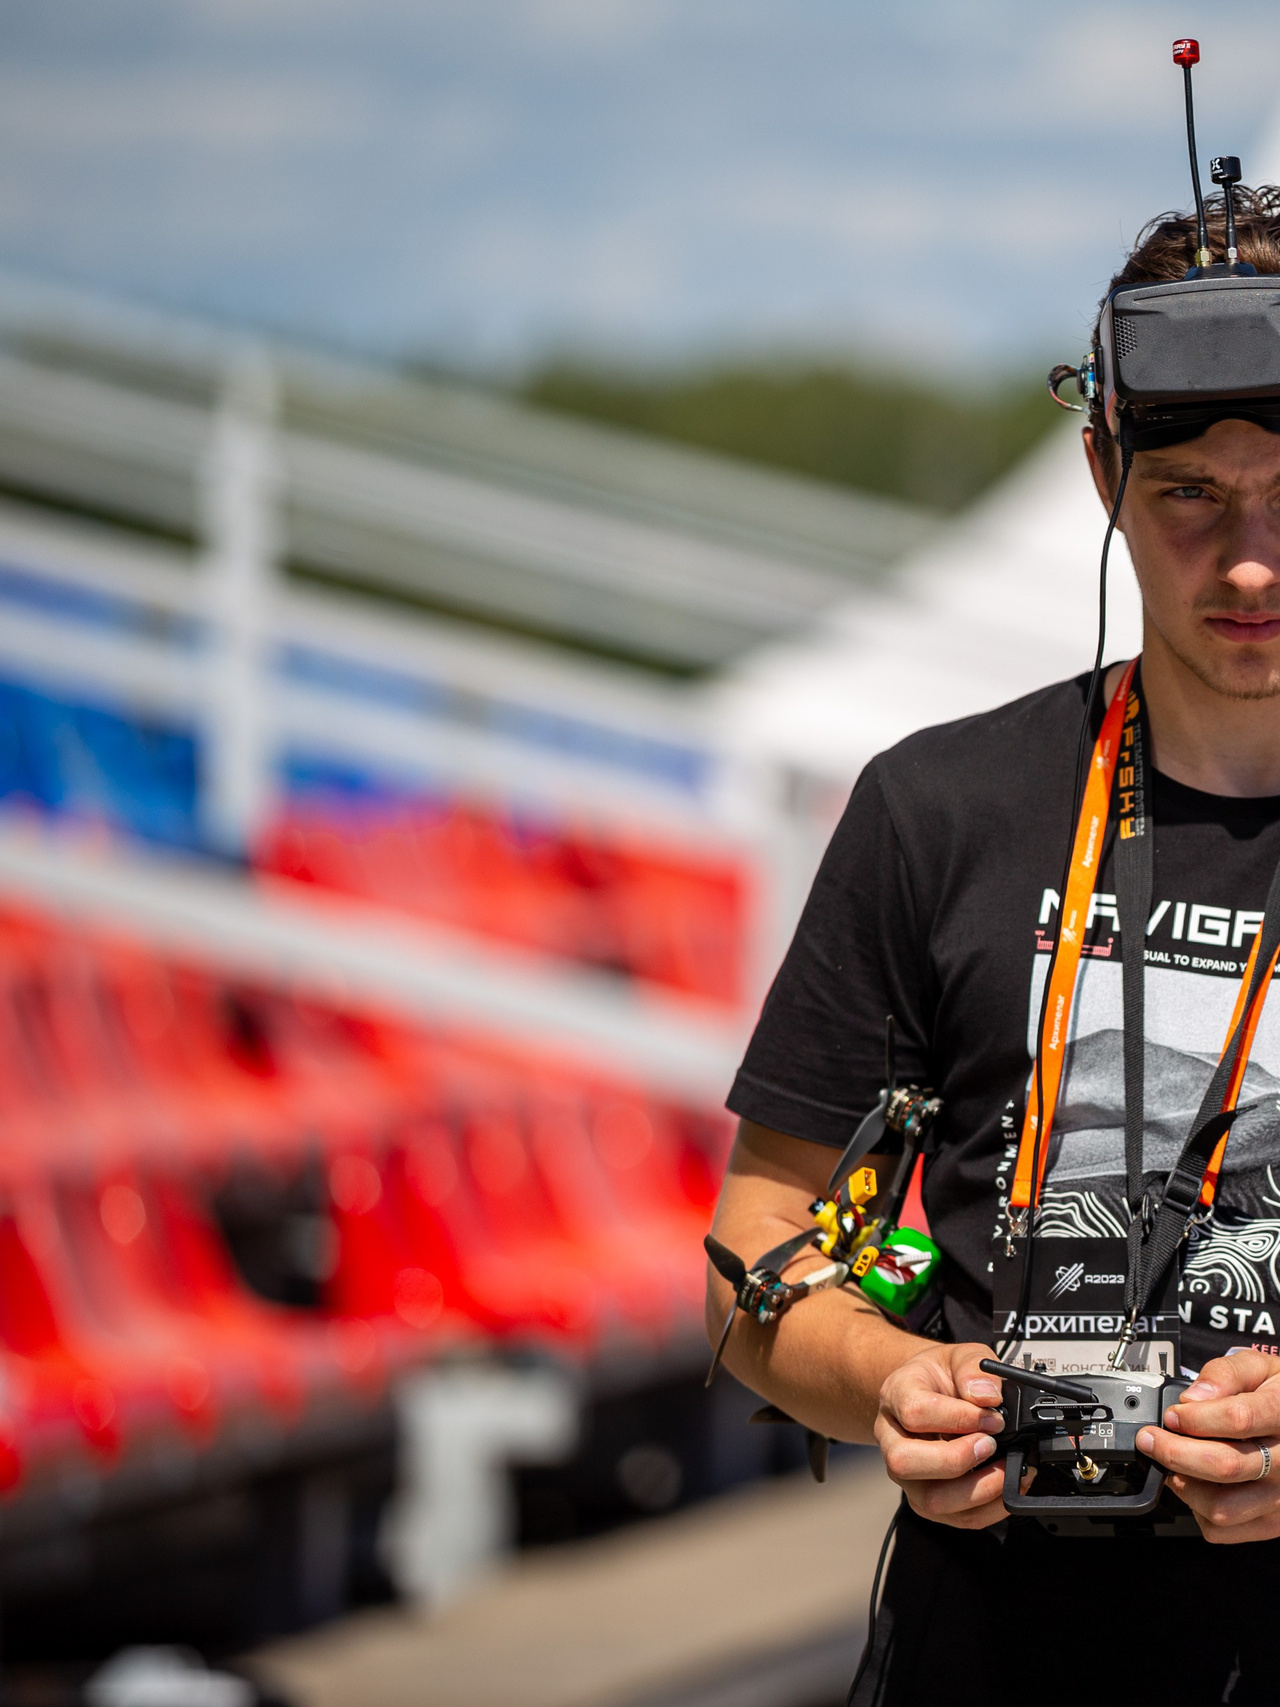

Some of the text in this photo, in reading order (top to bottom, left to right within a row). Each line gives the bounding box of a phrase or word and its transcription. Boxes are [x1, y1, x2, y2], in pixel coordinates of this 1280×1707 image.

[1143, 949, 1172, 964] SUAL
[1173, 953, 1190, 966] TO
[1191, 956, 1237, 972] EXPAND
